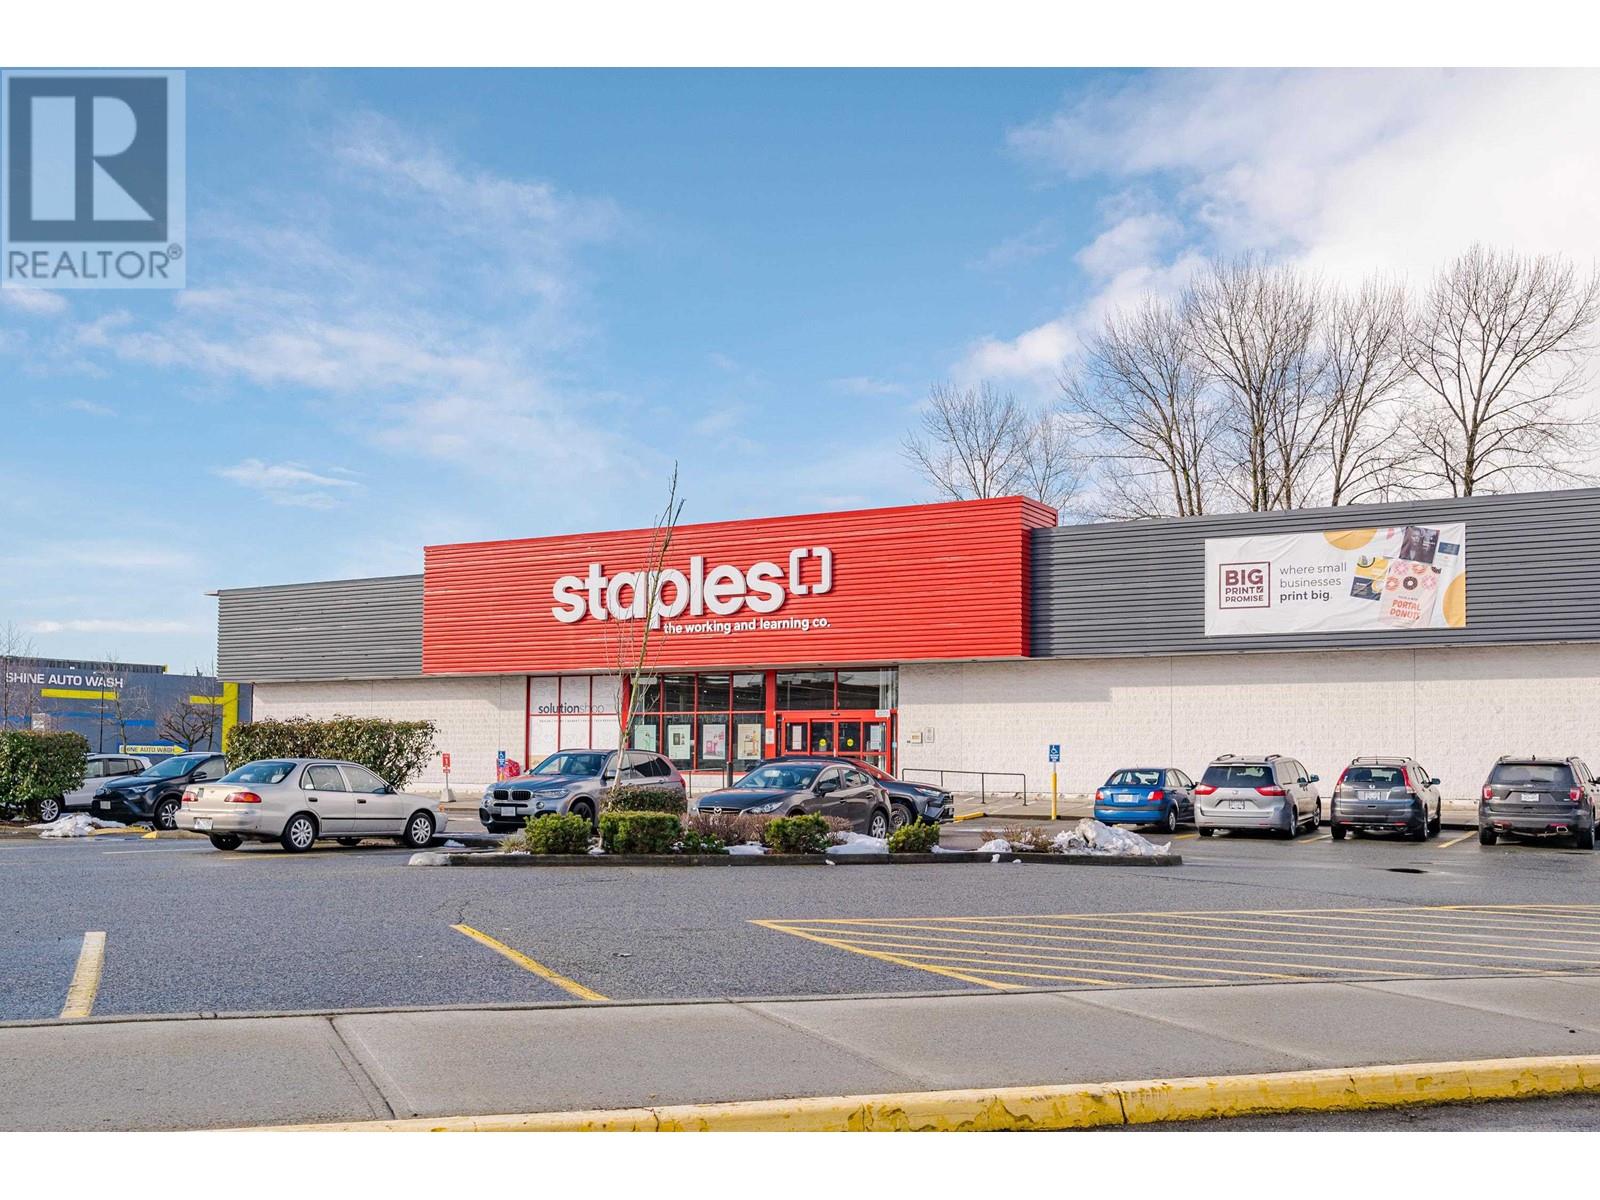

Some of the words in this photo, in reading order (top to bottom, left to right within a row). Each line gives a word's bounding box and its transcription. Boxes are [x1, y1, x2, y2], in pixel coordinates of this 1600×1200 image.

[1279, 564, 1315, 576] where
[1317, 562, 1347, 574] small
[1225, 568, 1264, 586] BIG
[1280, 576, 1342, 589] businesses
[551, 555, 786, 630] staples
[1225, 586, 1256, 595] PRINT
[1225, 595, 1264, 603] PROMISE
[1280, 591, 1310, 604] print
[1391, 599, 1421, 611] PORTAL
[663, 622, 683, 634] the
[685, 620, 731, 635] working
[734, 618, 756, 631] and
[760, 617, 809, 631] learning
[812, 617, 831, 628] co.
[5, 672, 45, 684] SHINE
[48, 674, 82, 686] AUTO
[85, 676, 124, 688] WASH
